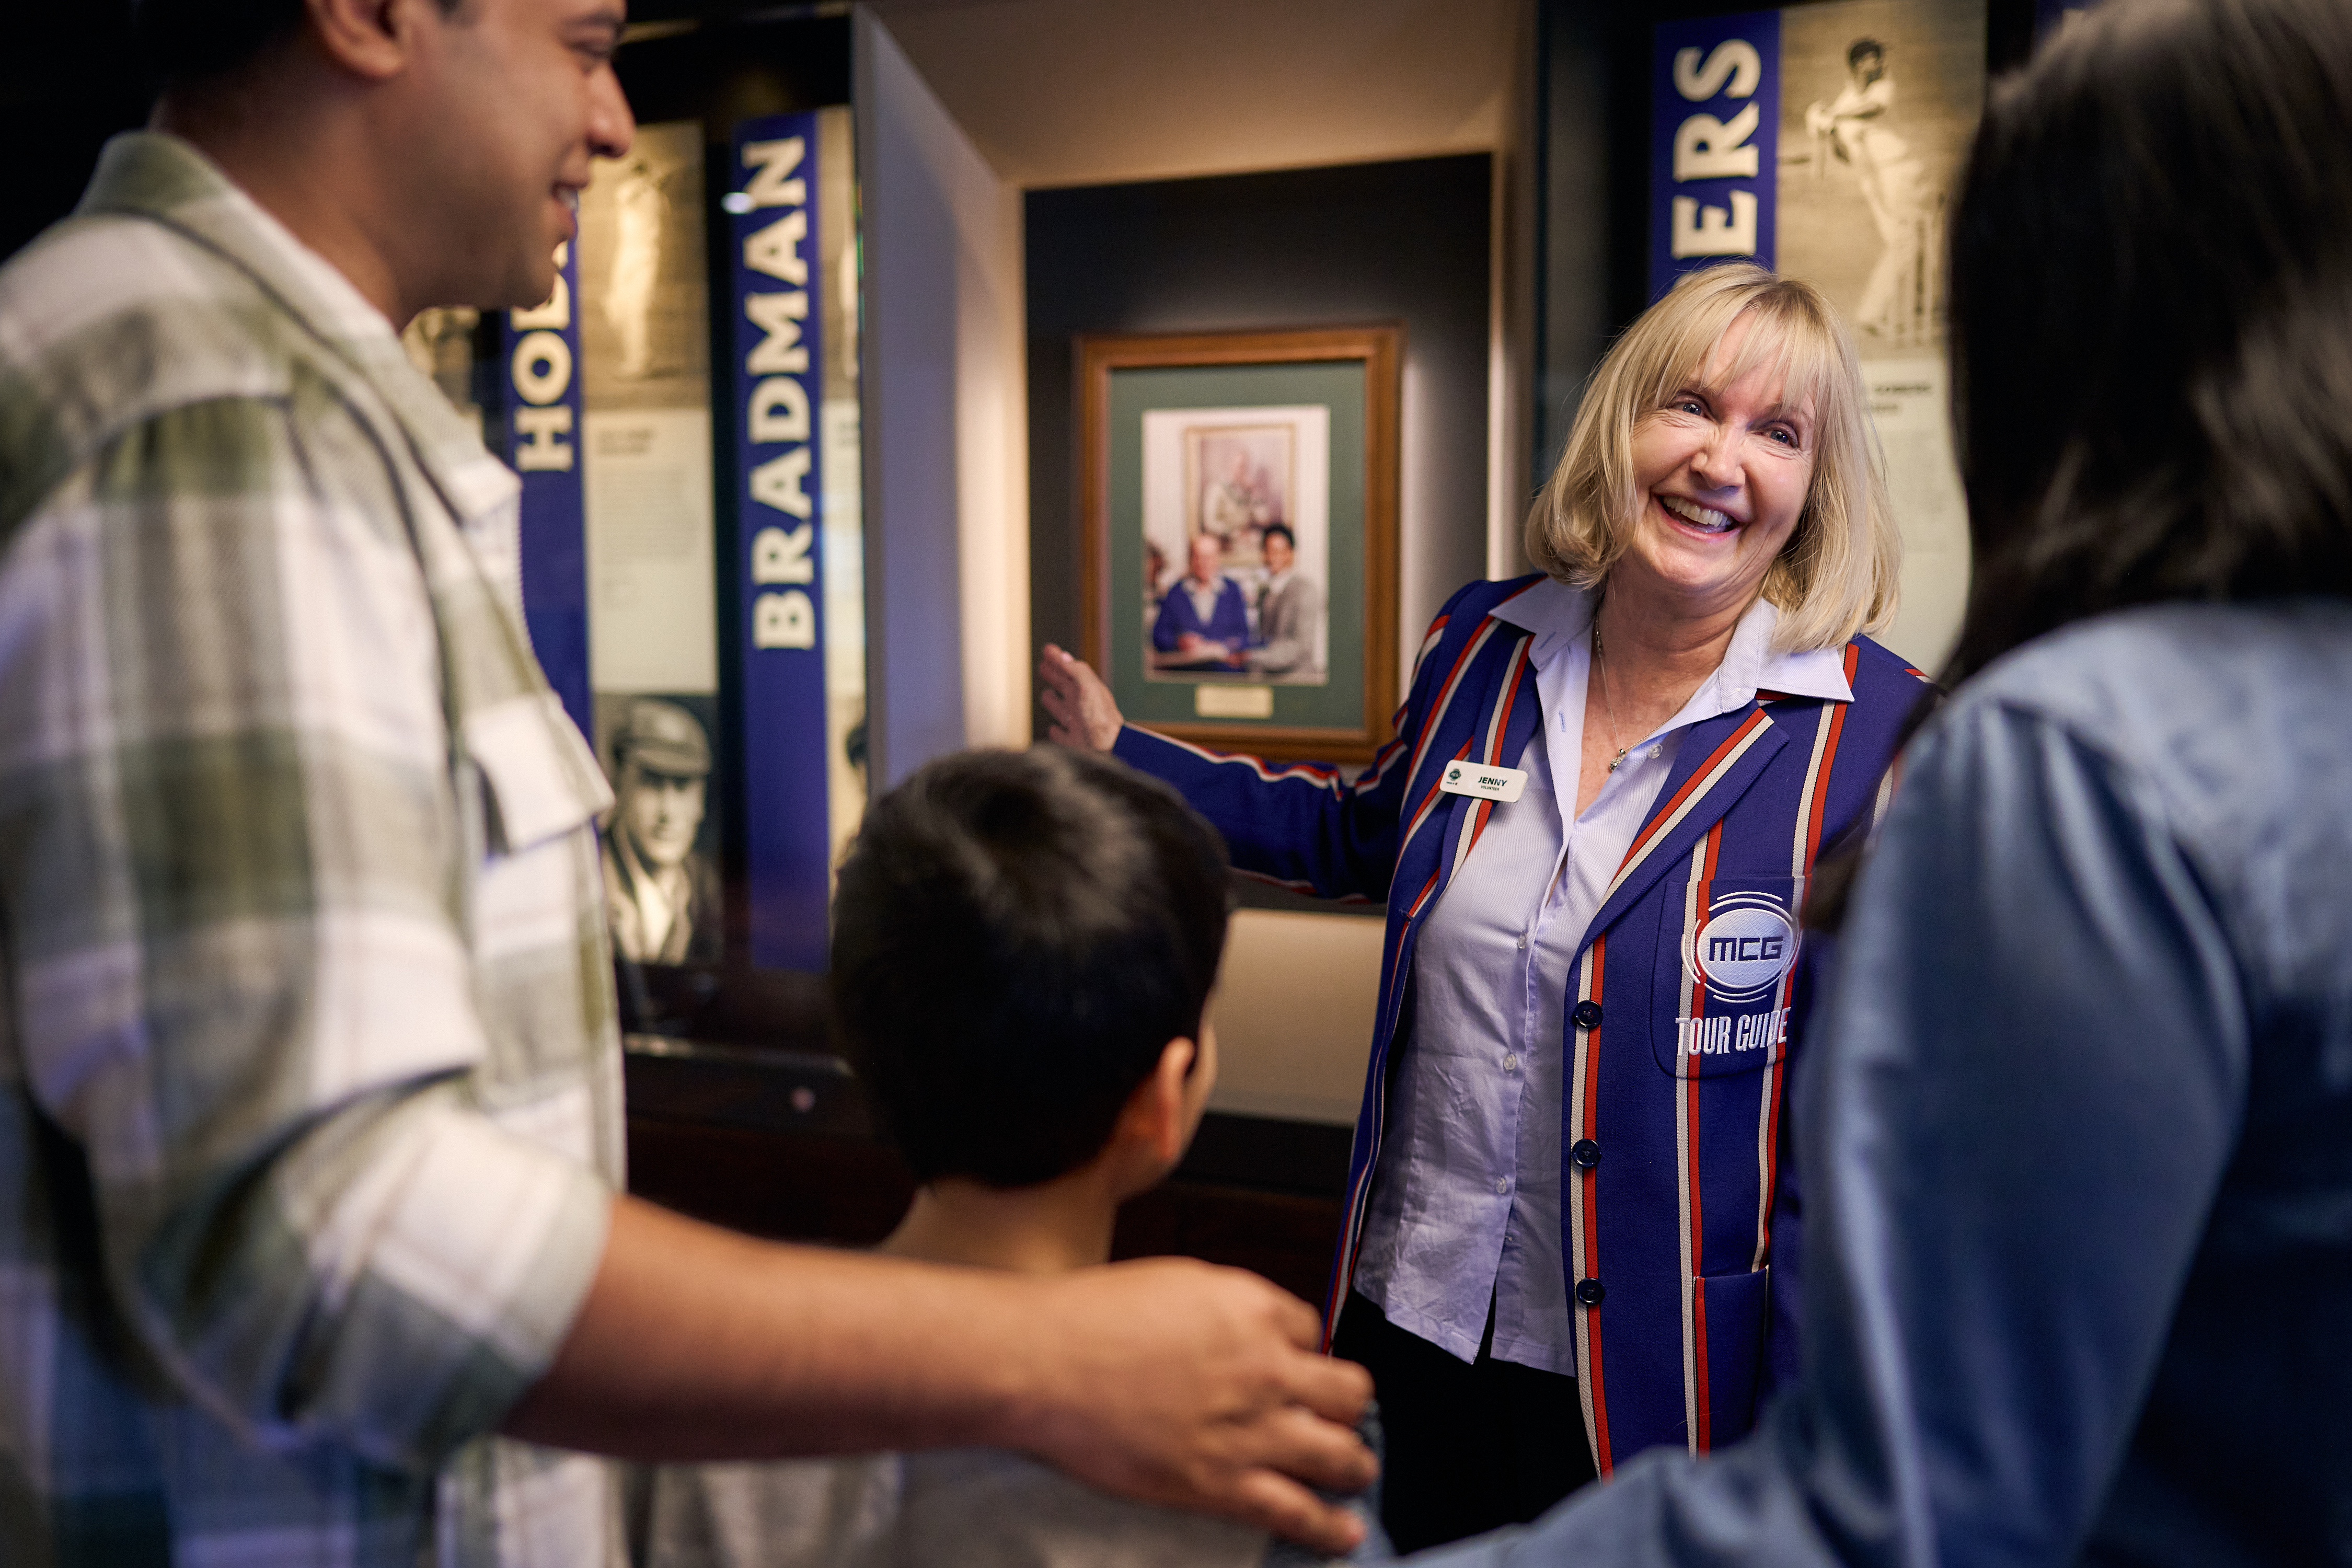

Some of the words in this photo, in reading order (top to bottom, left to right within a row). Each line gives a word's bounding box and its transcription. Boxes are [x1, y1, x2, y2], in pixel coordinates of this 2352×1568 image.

[1673, 38, 1761, 264] ERS
[741, 135, 815, 650] BRADMAN
[1478, 777, 1507, 787] JENNY
[1709, 936, 1783, 962] MCG
[1675, 1016, 1731, 1056] TOUR
[1735, 1007, 1791, 1052] GUIDE
